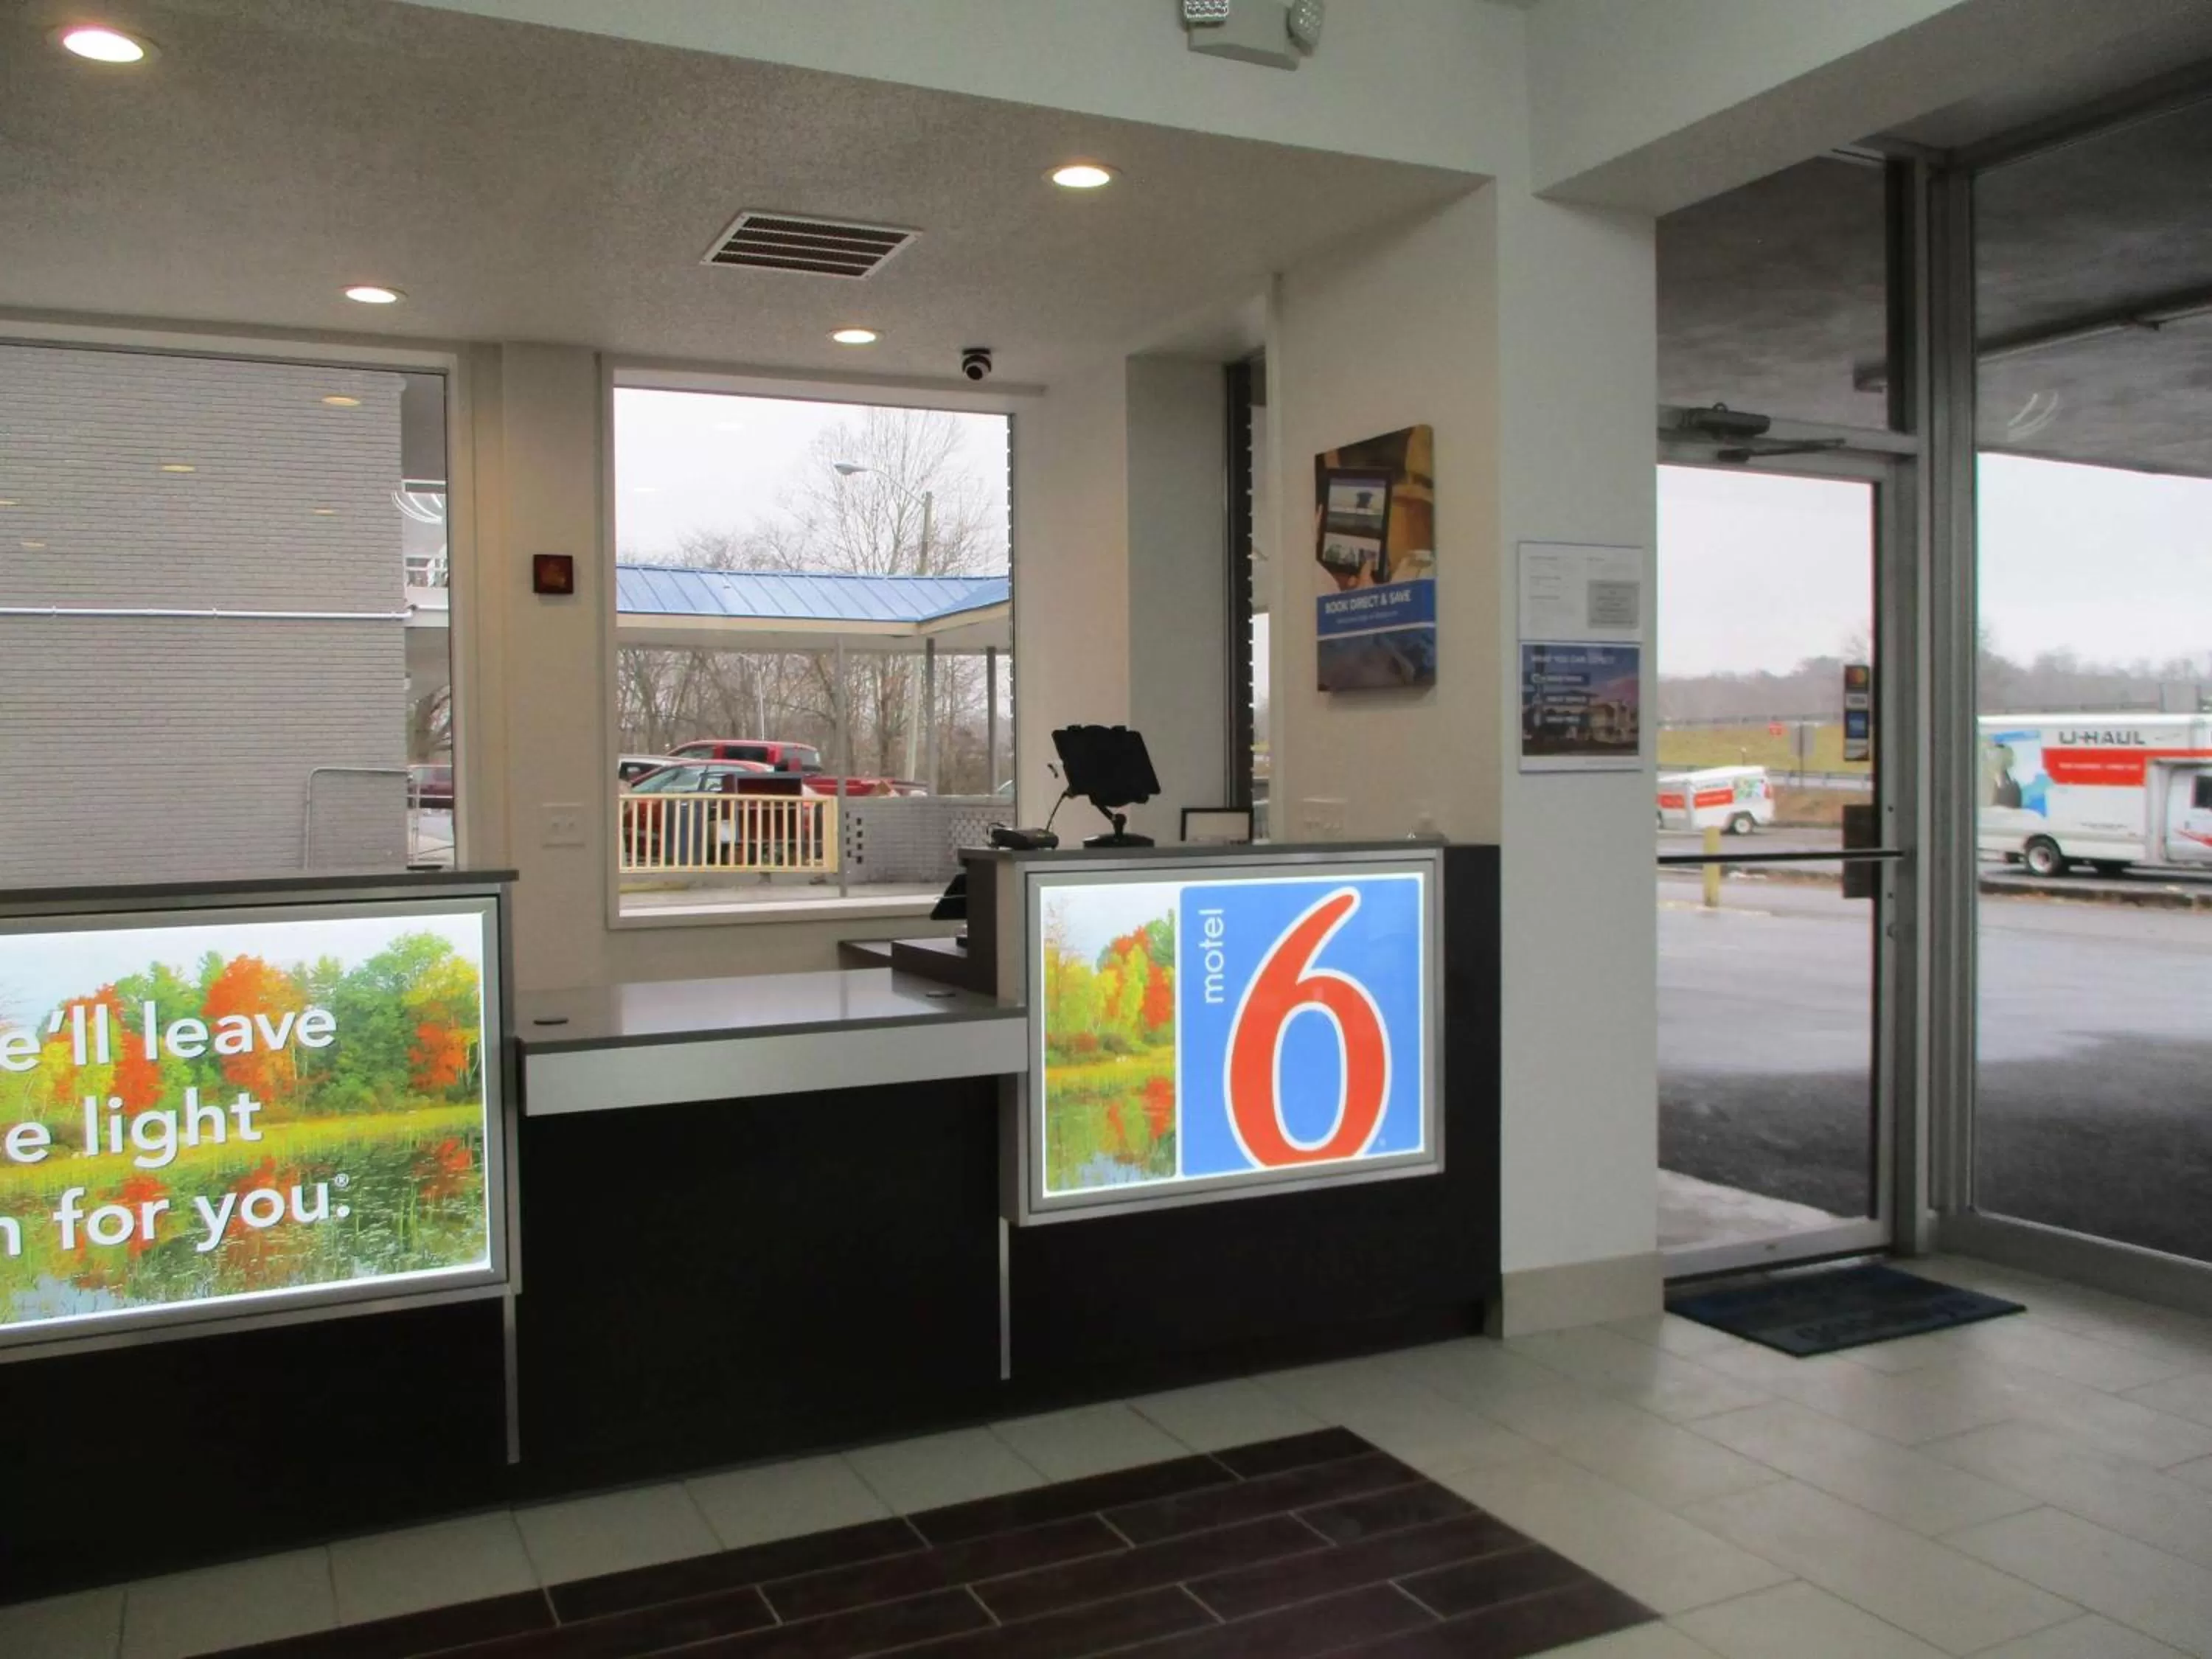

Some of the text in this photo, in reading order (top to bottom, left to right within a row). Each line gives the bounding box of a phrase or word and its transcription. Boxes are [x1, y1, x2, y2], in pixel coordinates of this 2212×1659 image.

[1325, 599, 1349, 614] BOOK
[1350, 595, 1379, 611] DIRECT
[1389, 589, 1412, 605] SAVE
[2058, 730, 2146, 745] U-HAUL
[1198, 908, 1225, 1004] motel
[143, 1000, 338, 1061] leave
[1223, 886, 1392, 1170] 6
[83, 1086, 263, 1169] light
[52, 1186, 170, 1251] for
